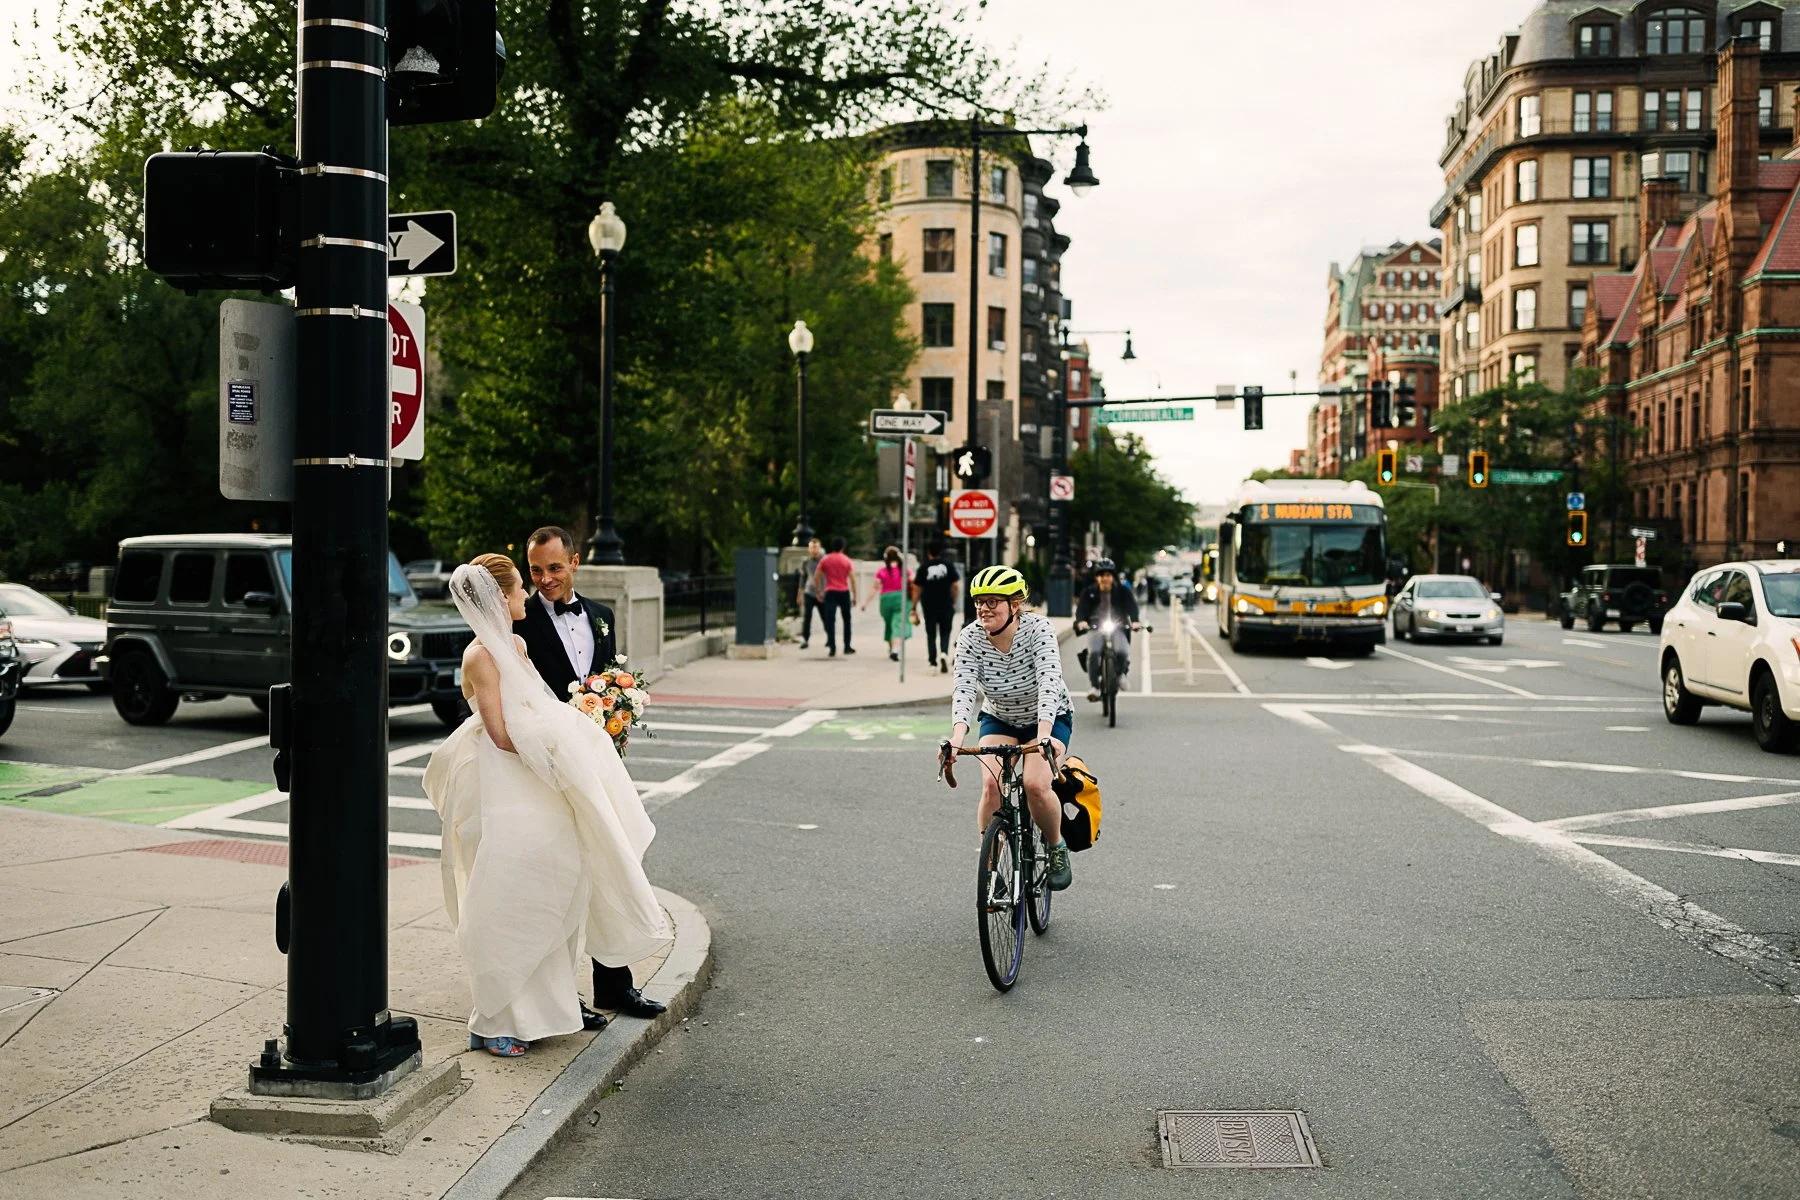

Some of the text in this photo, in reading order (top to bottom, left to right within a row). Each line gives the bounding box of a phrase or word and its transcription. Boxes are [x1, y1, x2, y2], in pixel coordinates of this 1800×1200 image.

[391, 333, 410, 358] OT
[879, 417, 922, 427] ONE WAY
[1260, 504, 1353, 520] 1 NUBIAN STA
[960, 519, 987, 528] ENTER
